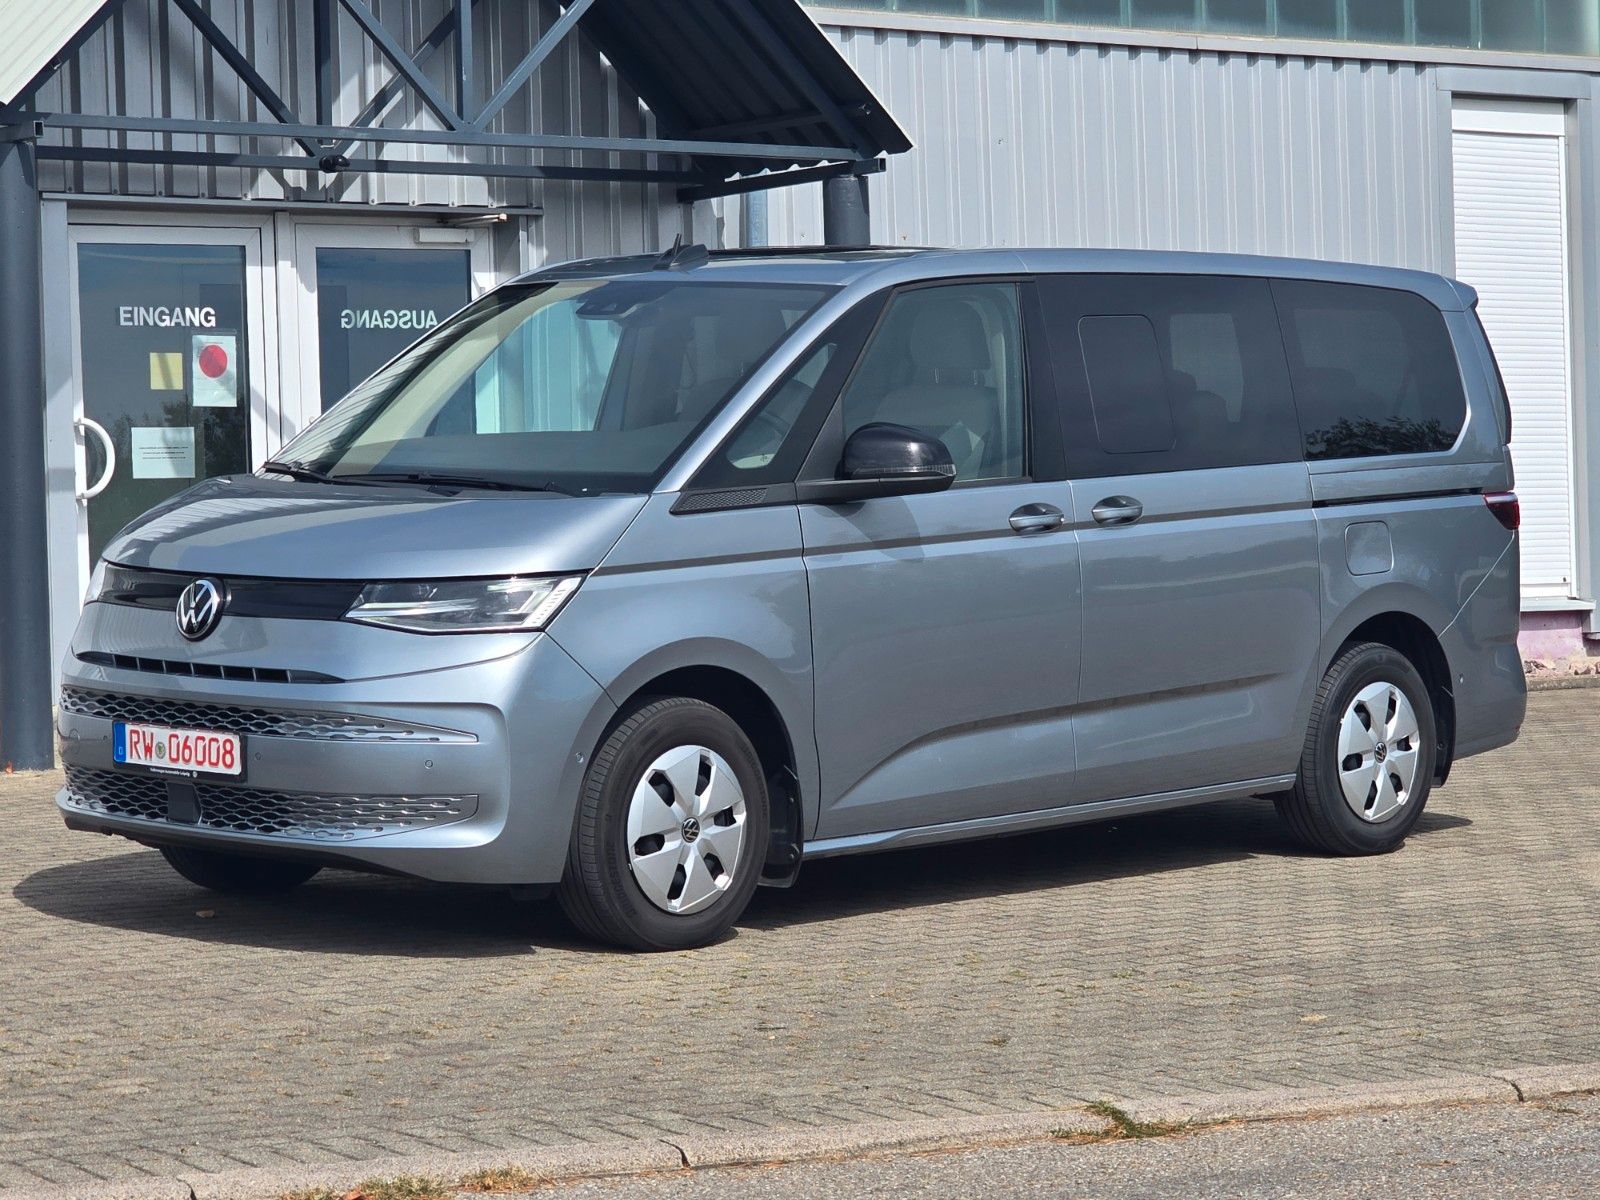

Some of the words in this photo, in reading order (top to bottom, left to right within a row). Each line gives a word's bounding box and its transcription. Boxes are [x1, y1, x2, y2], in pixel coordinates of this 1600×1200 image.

[119, 306, 216, 327] EINGANG
[129, 729, 154, 760] RW
[168, 733, 235, 769] 06008
